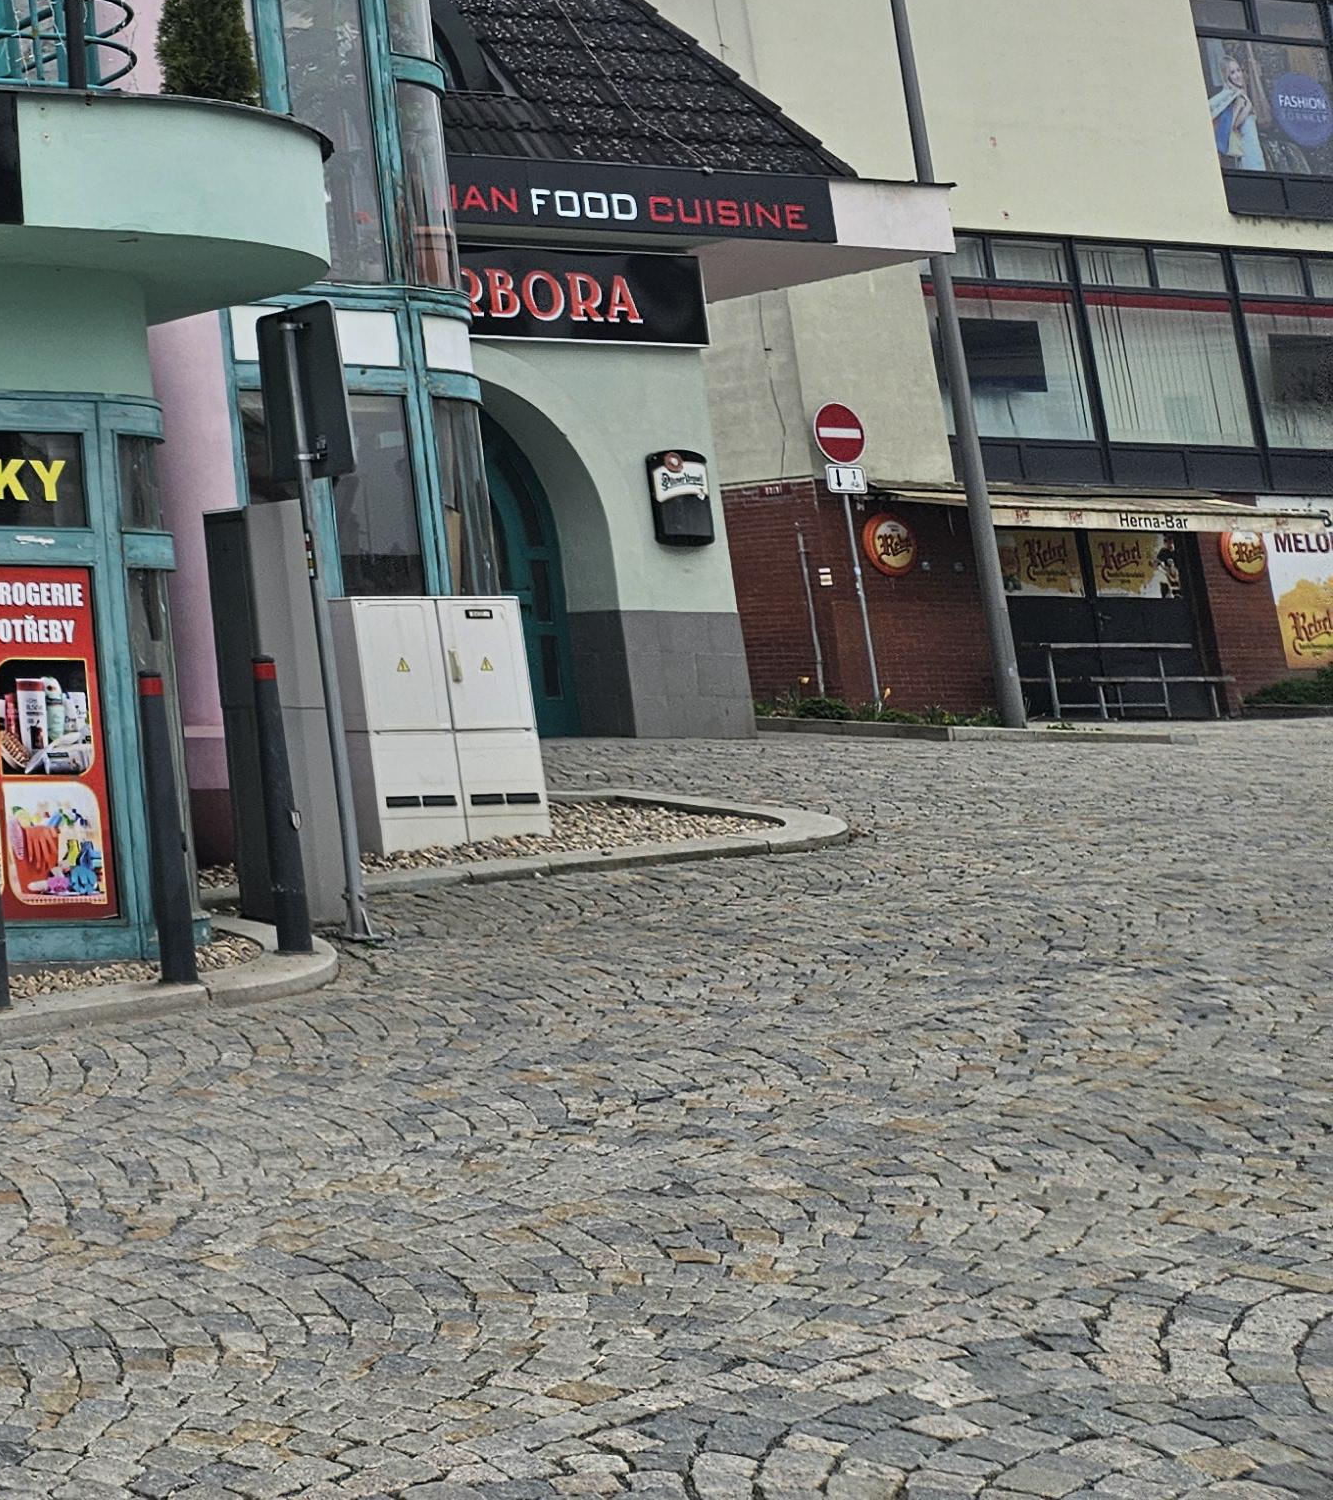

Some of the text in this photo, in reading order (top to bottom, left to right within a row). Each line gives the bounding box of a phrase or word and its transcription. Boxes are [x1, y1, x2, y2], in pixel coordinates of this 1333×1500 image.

[449, 184, 809, 231] IAN FOOD CUISINE
[459, 266, 644, 324] RBORA
[1118, 512, 1189, 530] Herna-Bar
